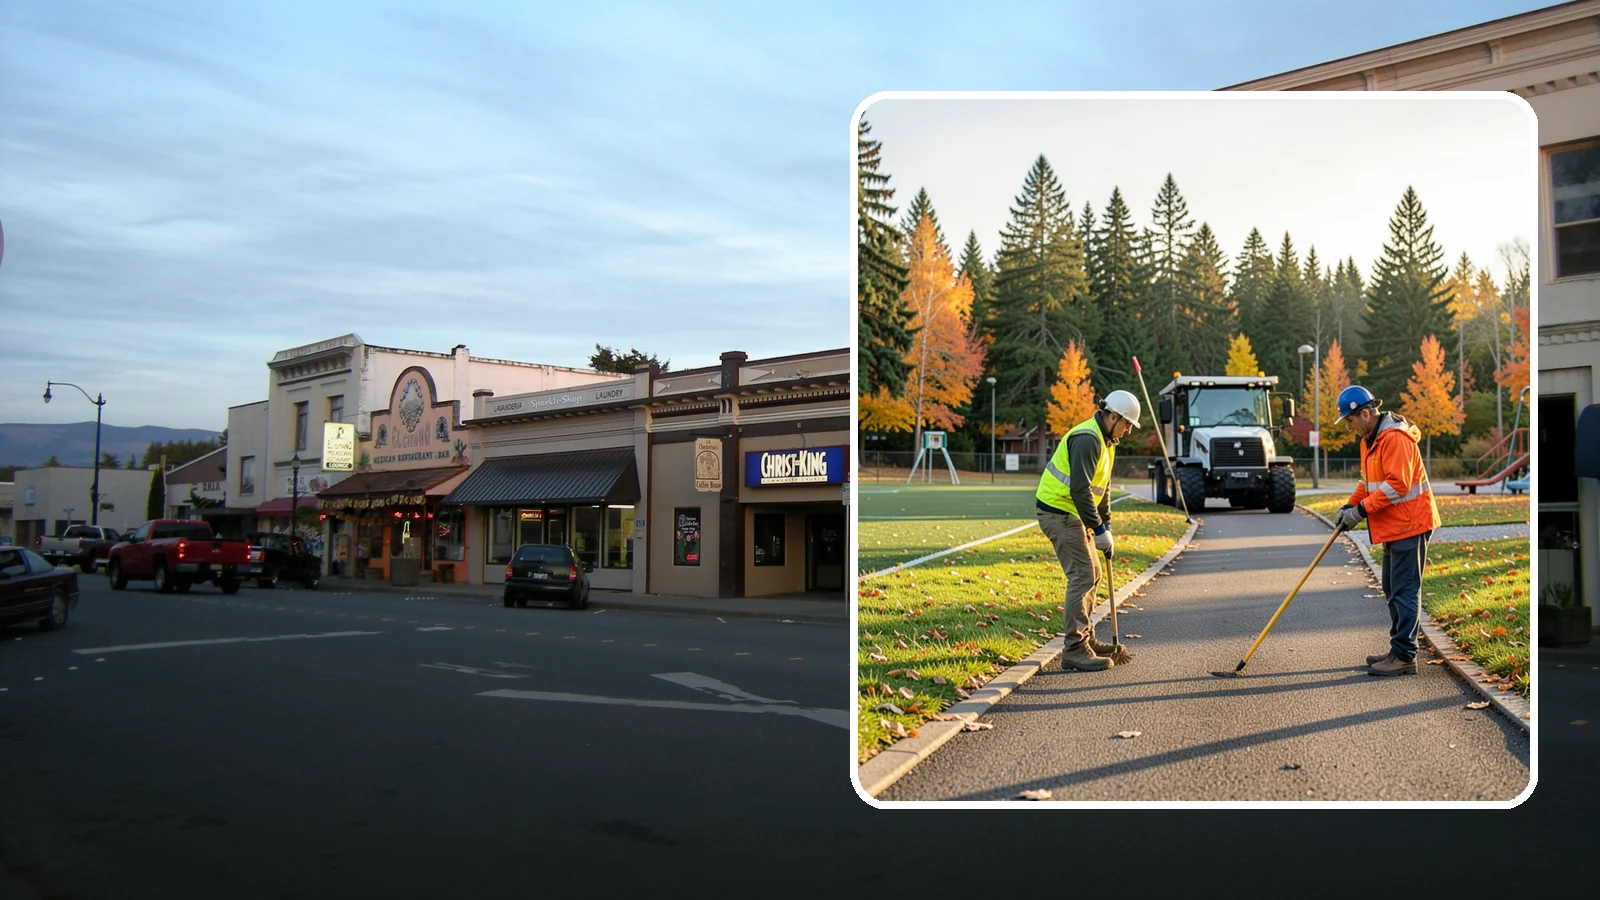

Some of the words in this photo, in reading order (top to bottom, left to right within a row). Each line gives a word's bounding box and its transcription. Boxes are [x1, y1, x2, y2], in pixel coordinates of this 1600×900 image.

[596, 389, 623, 400] LAUNDRY
[373, 455, 396, 464] MEXICAN
[398, 451, 433, 463] RESTAURANT
[437, 450, 450, 459] BAR
[761, 451, 797, 478] CHRIST
[799, 450, 827, 476] KING
